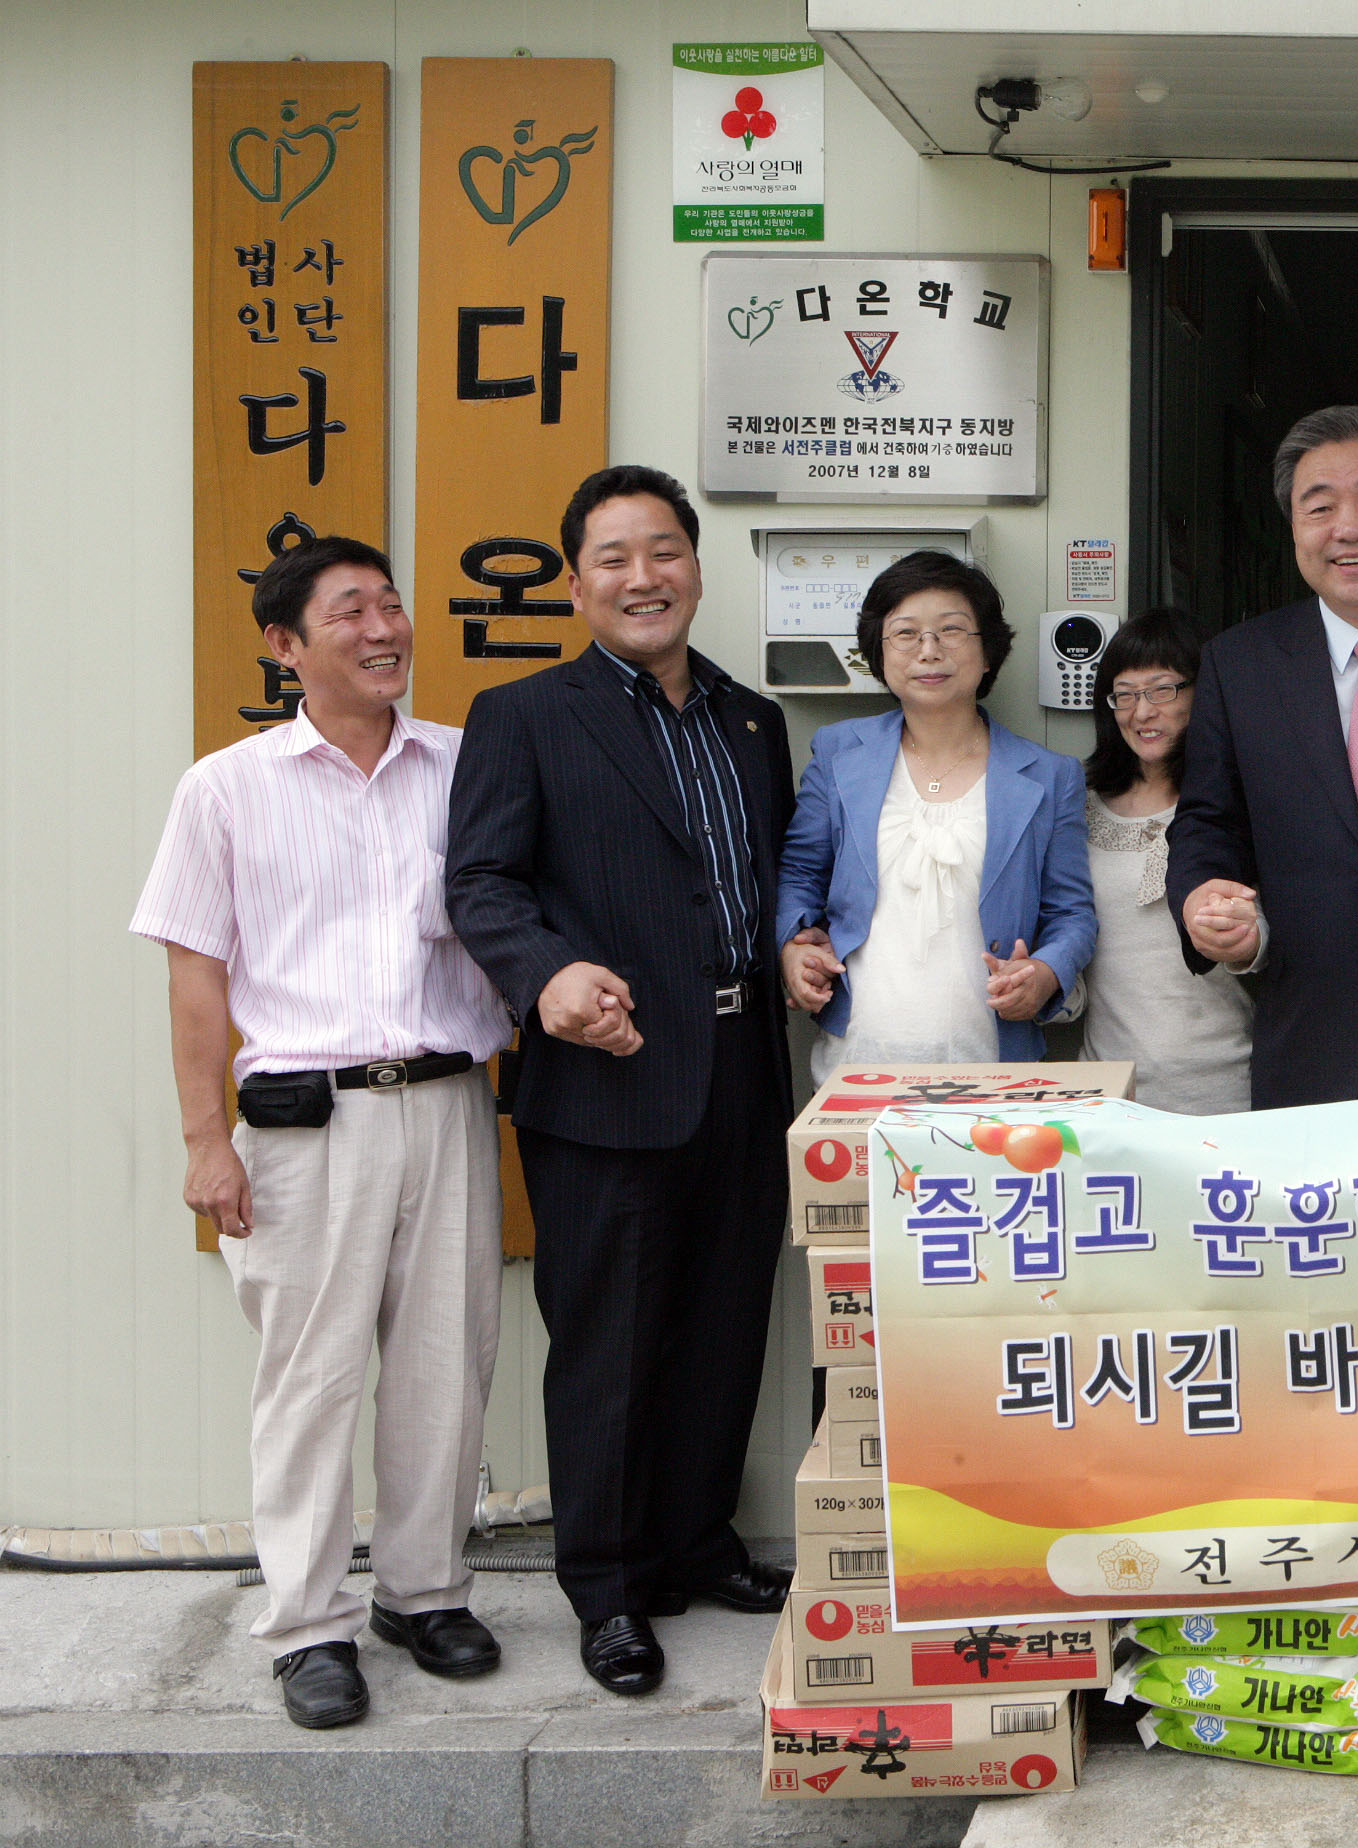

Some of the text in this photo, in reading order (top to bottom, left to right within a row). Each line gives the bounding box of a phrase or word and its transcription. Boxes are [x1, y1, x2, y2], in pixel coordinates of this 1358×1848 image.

[796, 279, 1013, 332] 다온학교
[726, 415, 1015, 437] 국제와이즈멘 한국전북지구 동지방
[727, 440, 738, 455] 본
[742, 440, 777, 455] 건물은
[808, 464, 931, 479] 2007년 12월 8일
[905, 1167, 1156, 1285] 즐겁고
[997, 1324, 1242, 1435] 되시길
[1246, 1617, 1332, 1651] 가나안
[1240, 1676, 1325, 1714] 가나안
[1253, 1725, 1335, 1766] 가나안
